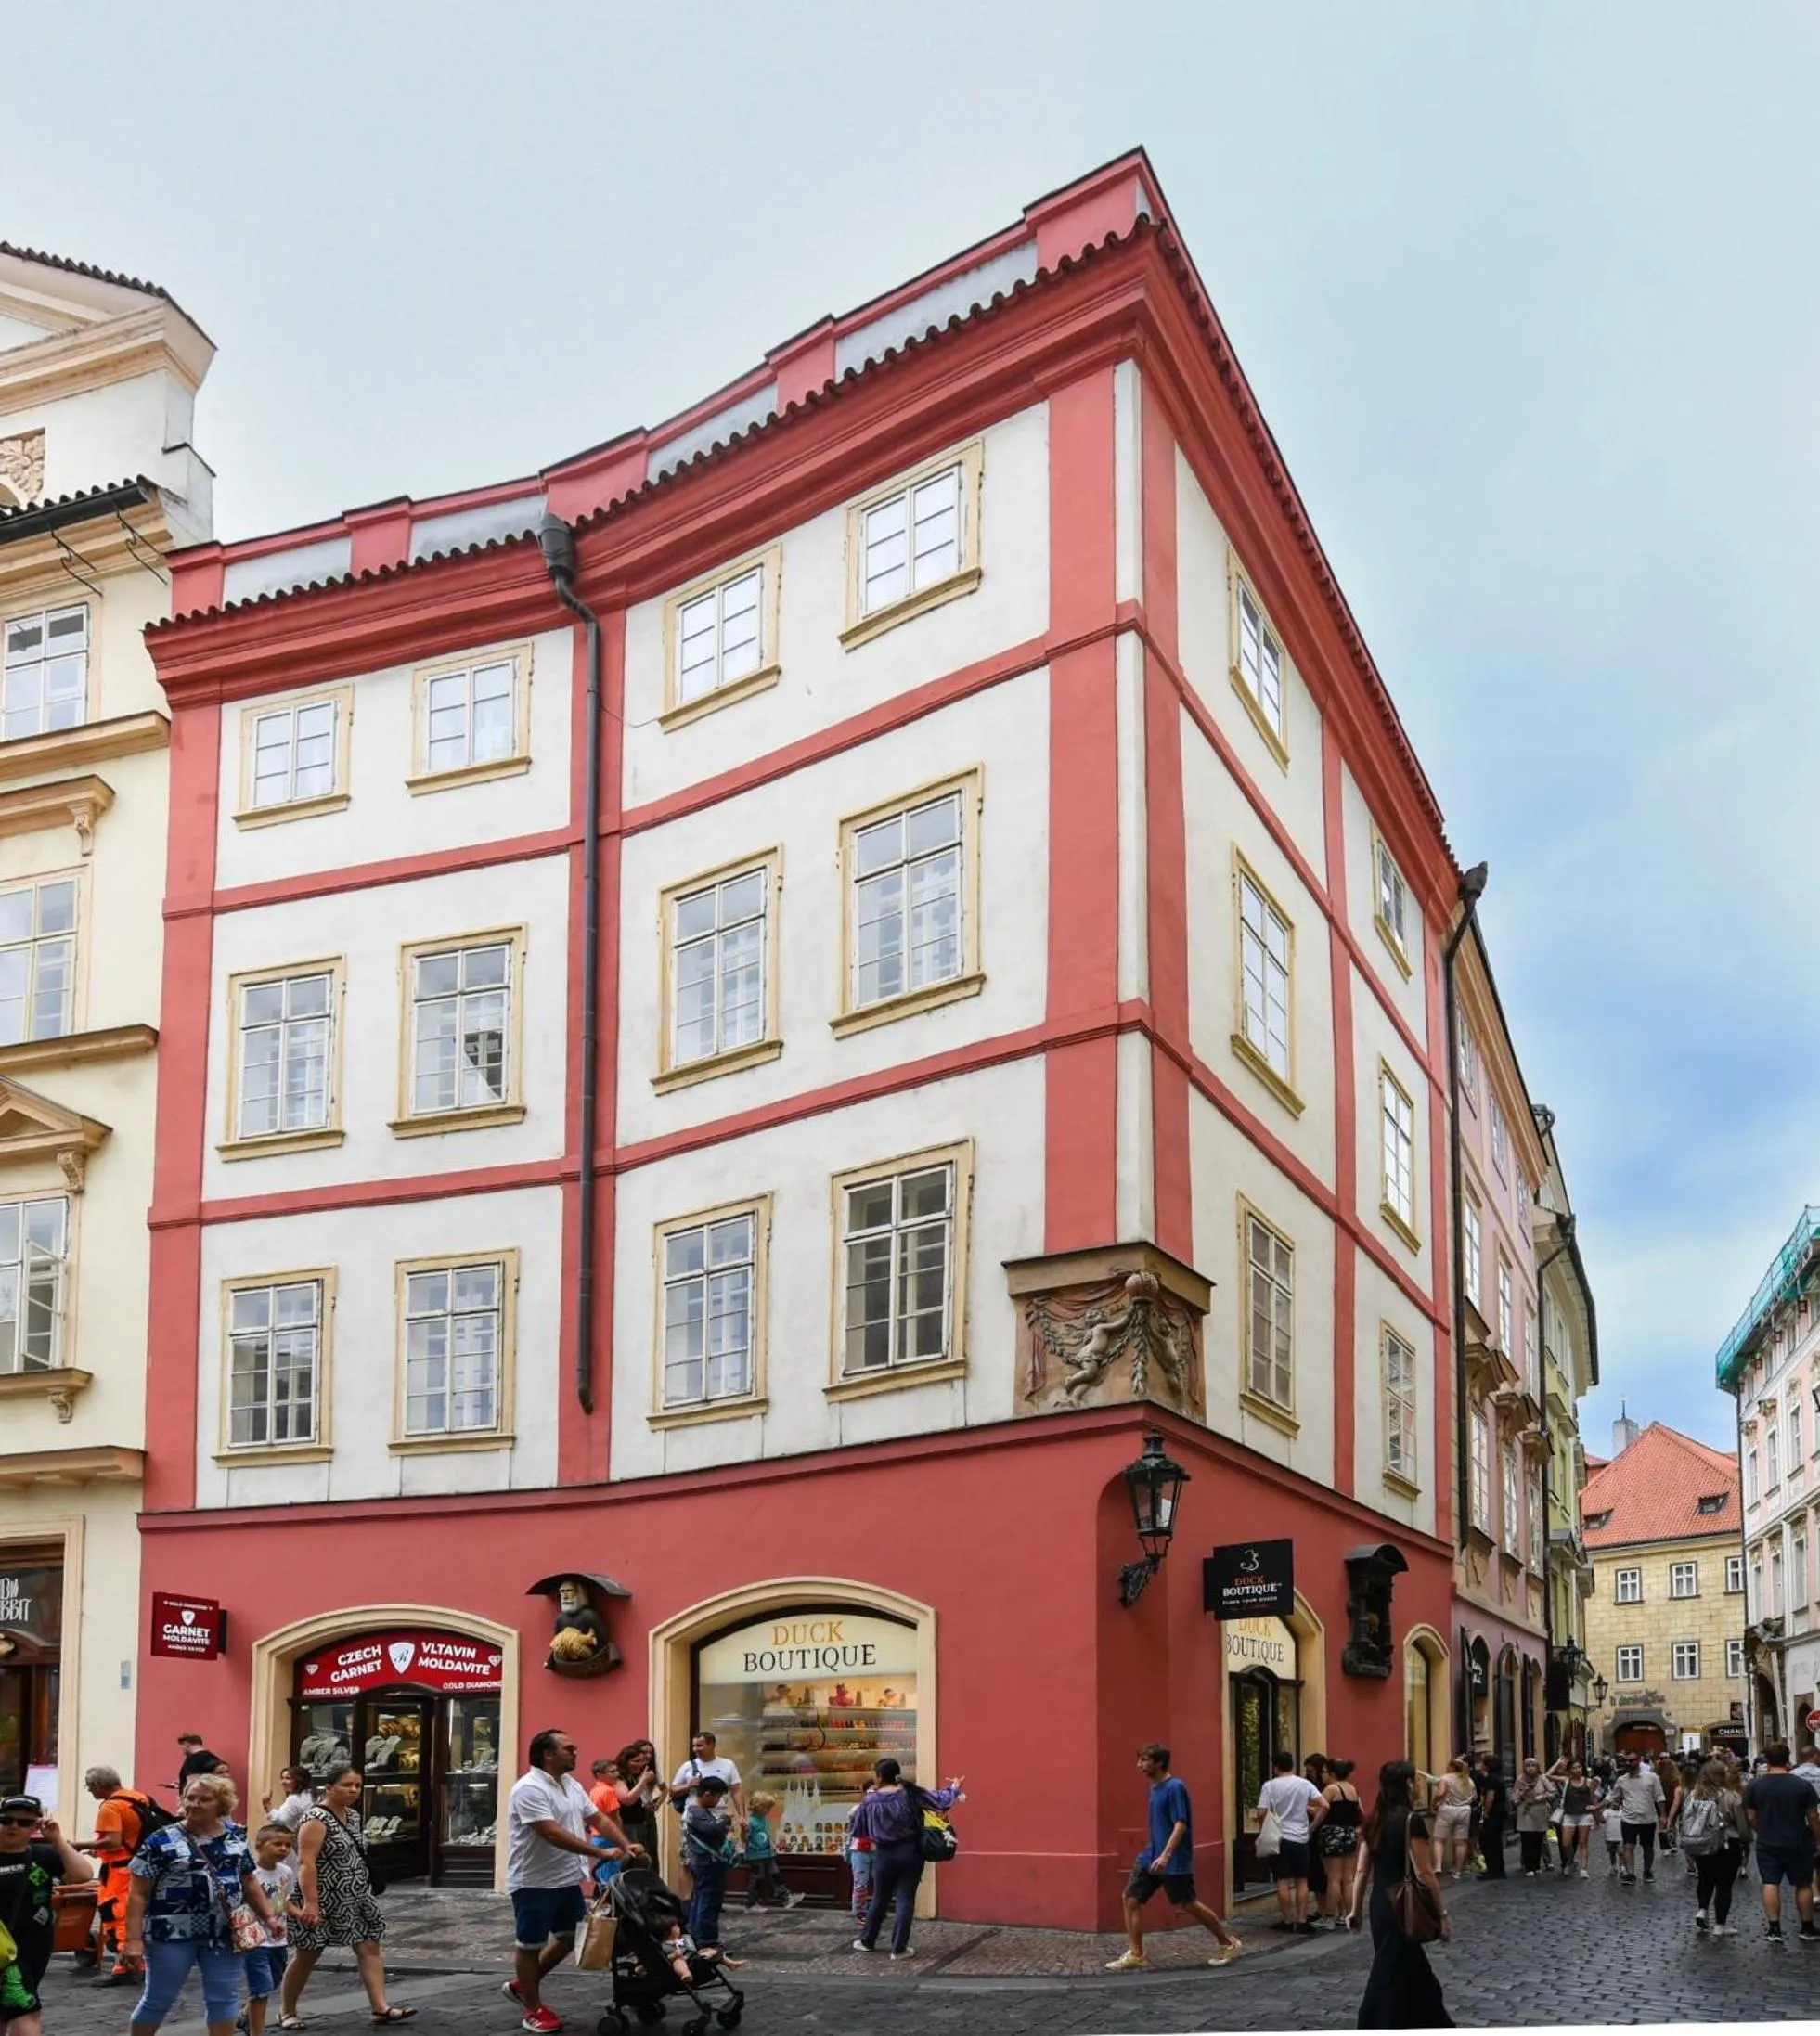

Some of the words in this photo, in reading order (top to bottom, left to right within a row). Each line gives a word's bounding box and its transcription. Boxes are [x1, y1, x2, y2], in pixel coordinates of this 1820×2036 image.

[1222, 1583, 1278, 1597] BOUTIQUE
[1235, 1576, 1265, 1586] DUCK
[162, 1634, 211, 1646] MOLDAVITE
[163, 1624, 211, 1639] GARNET
[772, 1620, 844, 1646] DUCK
[337, 1644, 382, 1666] CZECH
[421, 1642, 477, 1659] VLTAVIN
[742, 1644, 876, 1672] BOUTIQUE
[330, 1659, 382, 1682] GARNET
[418, 1656, 491, 1675] MOLDAVITE
